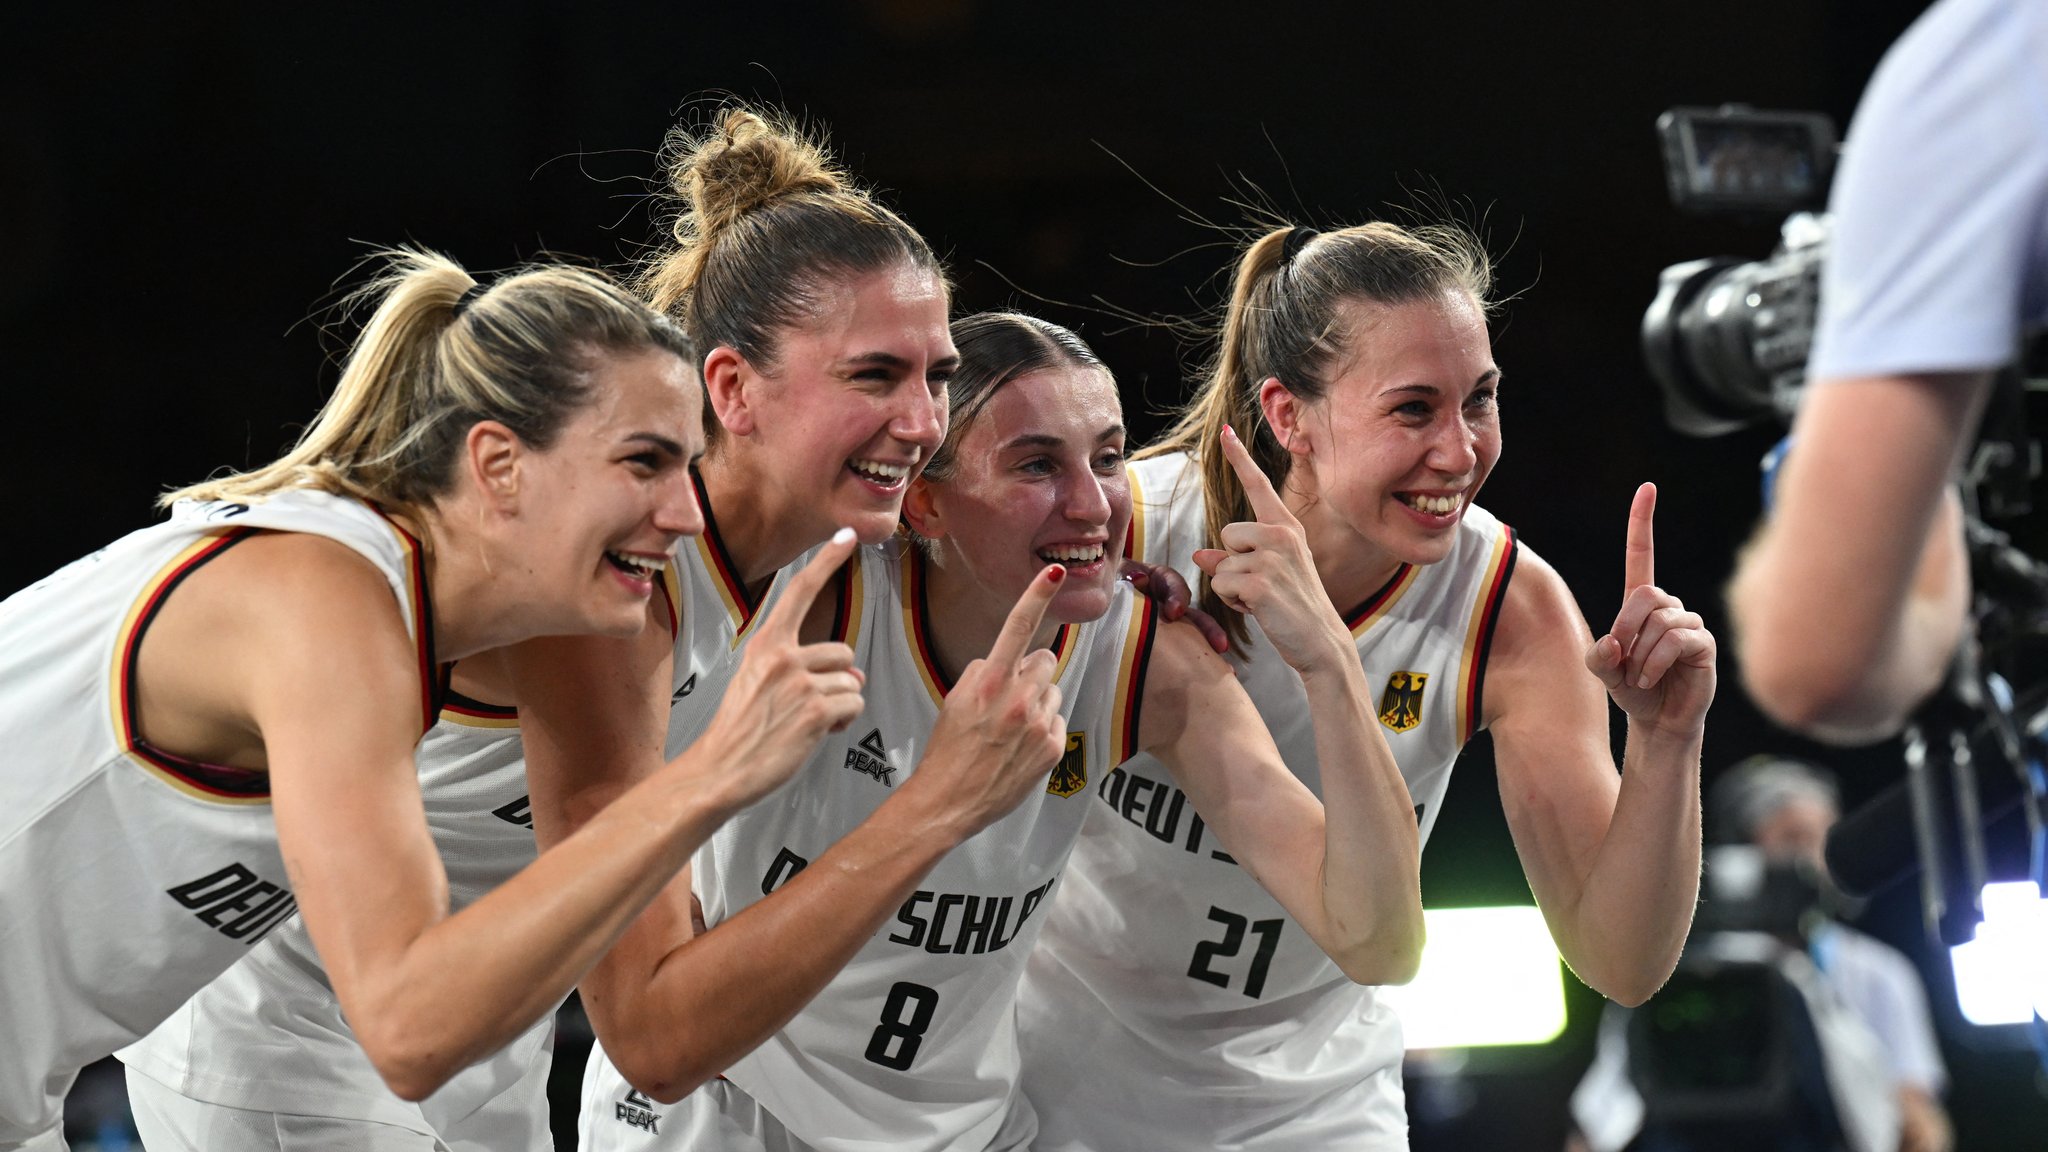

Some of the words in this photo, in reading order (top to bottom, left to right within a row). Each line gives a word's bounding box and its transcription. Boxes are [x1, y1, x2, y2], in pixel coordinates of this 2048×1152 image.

[844, 747, 897, 788] PEAK
[1098, 767, 1239, 865] DEUT
[1187, 905, 1285, 1000] 21
[864, 981, 939, 1071] 8
[615, 1101, 662, 1136] PEAK
